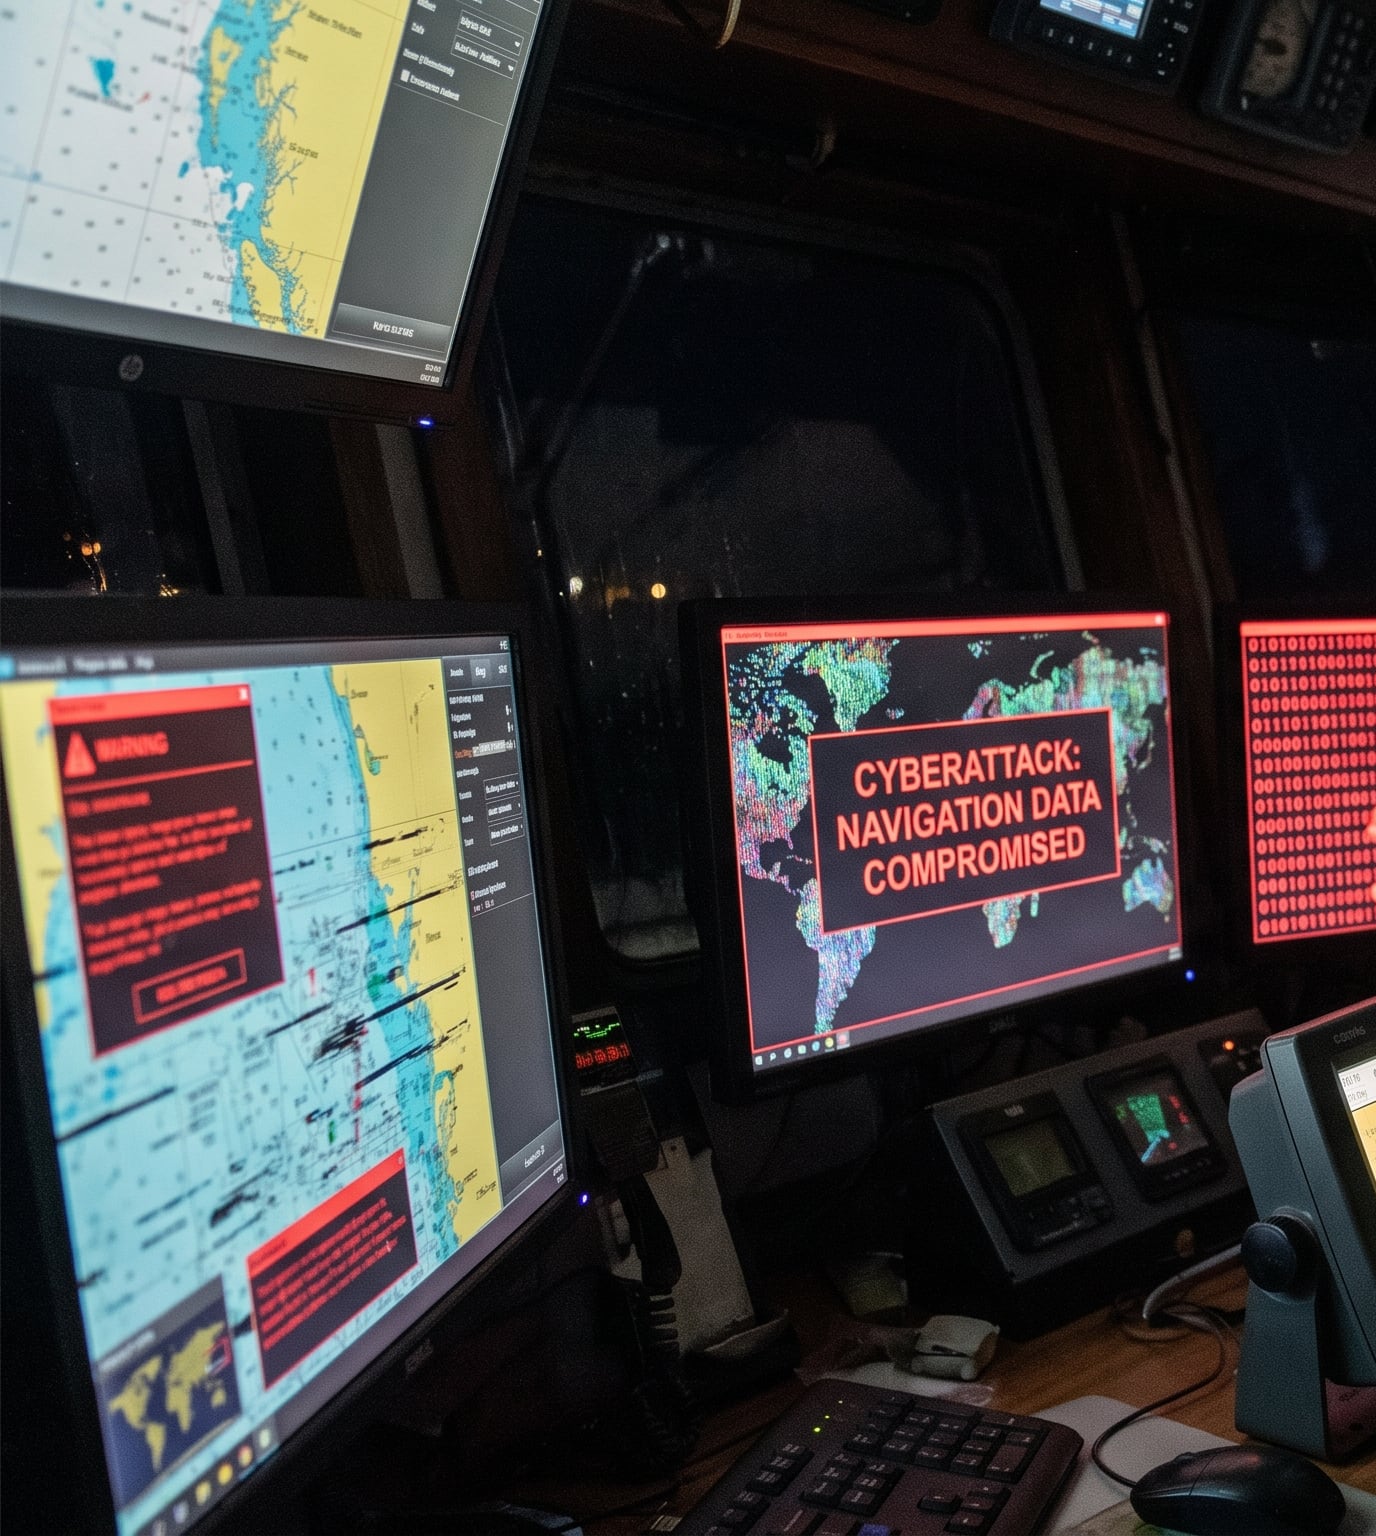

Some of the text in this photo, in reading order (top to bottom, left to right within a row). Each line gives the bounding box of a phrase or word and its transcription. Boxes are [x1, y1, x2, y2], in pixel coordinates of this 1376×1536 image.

[855, 739, 1081, 797] CYBERATTACK:
[837, 780, 1102, 850] NAVIGATION DATA
[864, 826, 1086, 895] COMPROMISED
